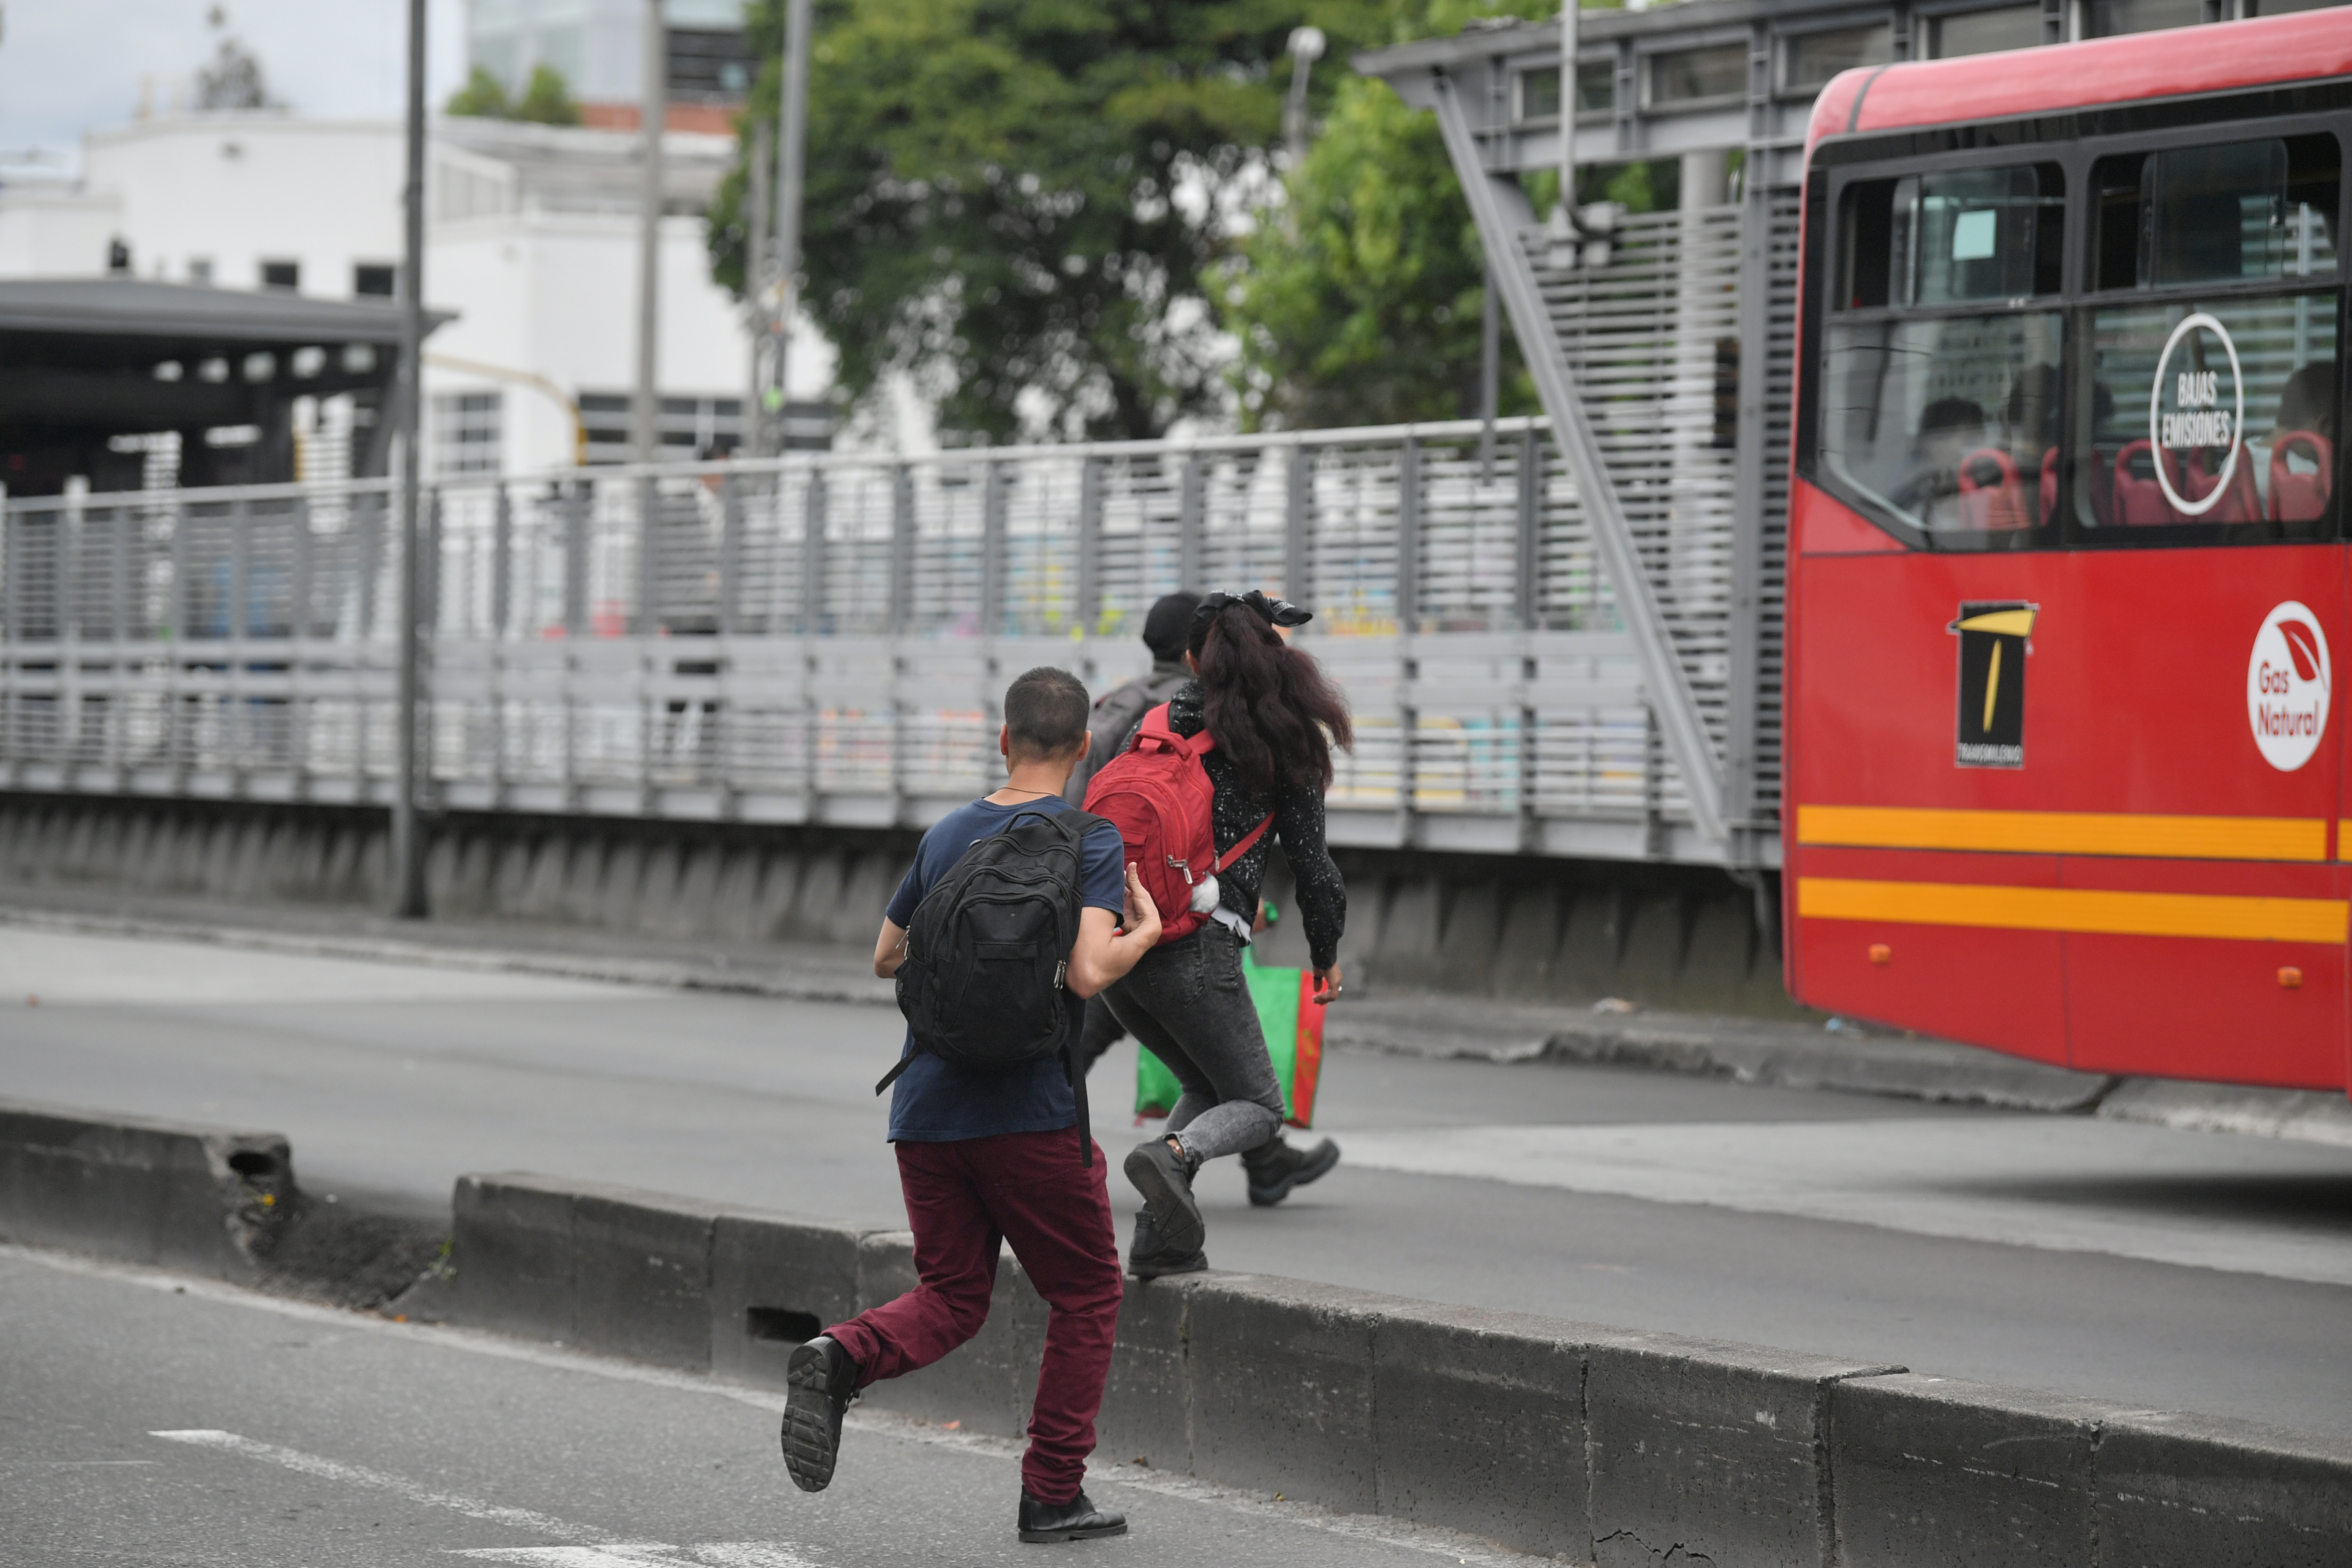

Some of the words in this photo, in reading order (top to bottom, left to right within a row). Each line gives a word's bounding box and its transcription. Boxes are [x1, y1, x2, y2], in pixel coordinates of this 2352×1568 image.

[2178, 370, 2217, 407] BAJAS
[2162, 410, 2230, 448] EMISIONES
[2259, 661, 2289, 694] Gas
[2258, 699, 2319, 736] Natural
